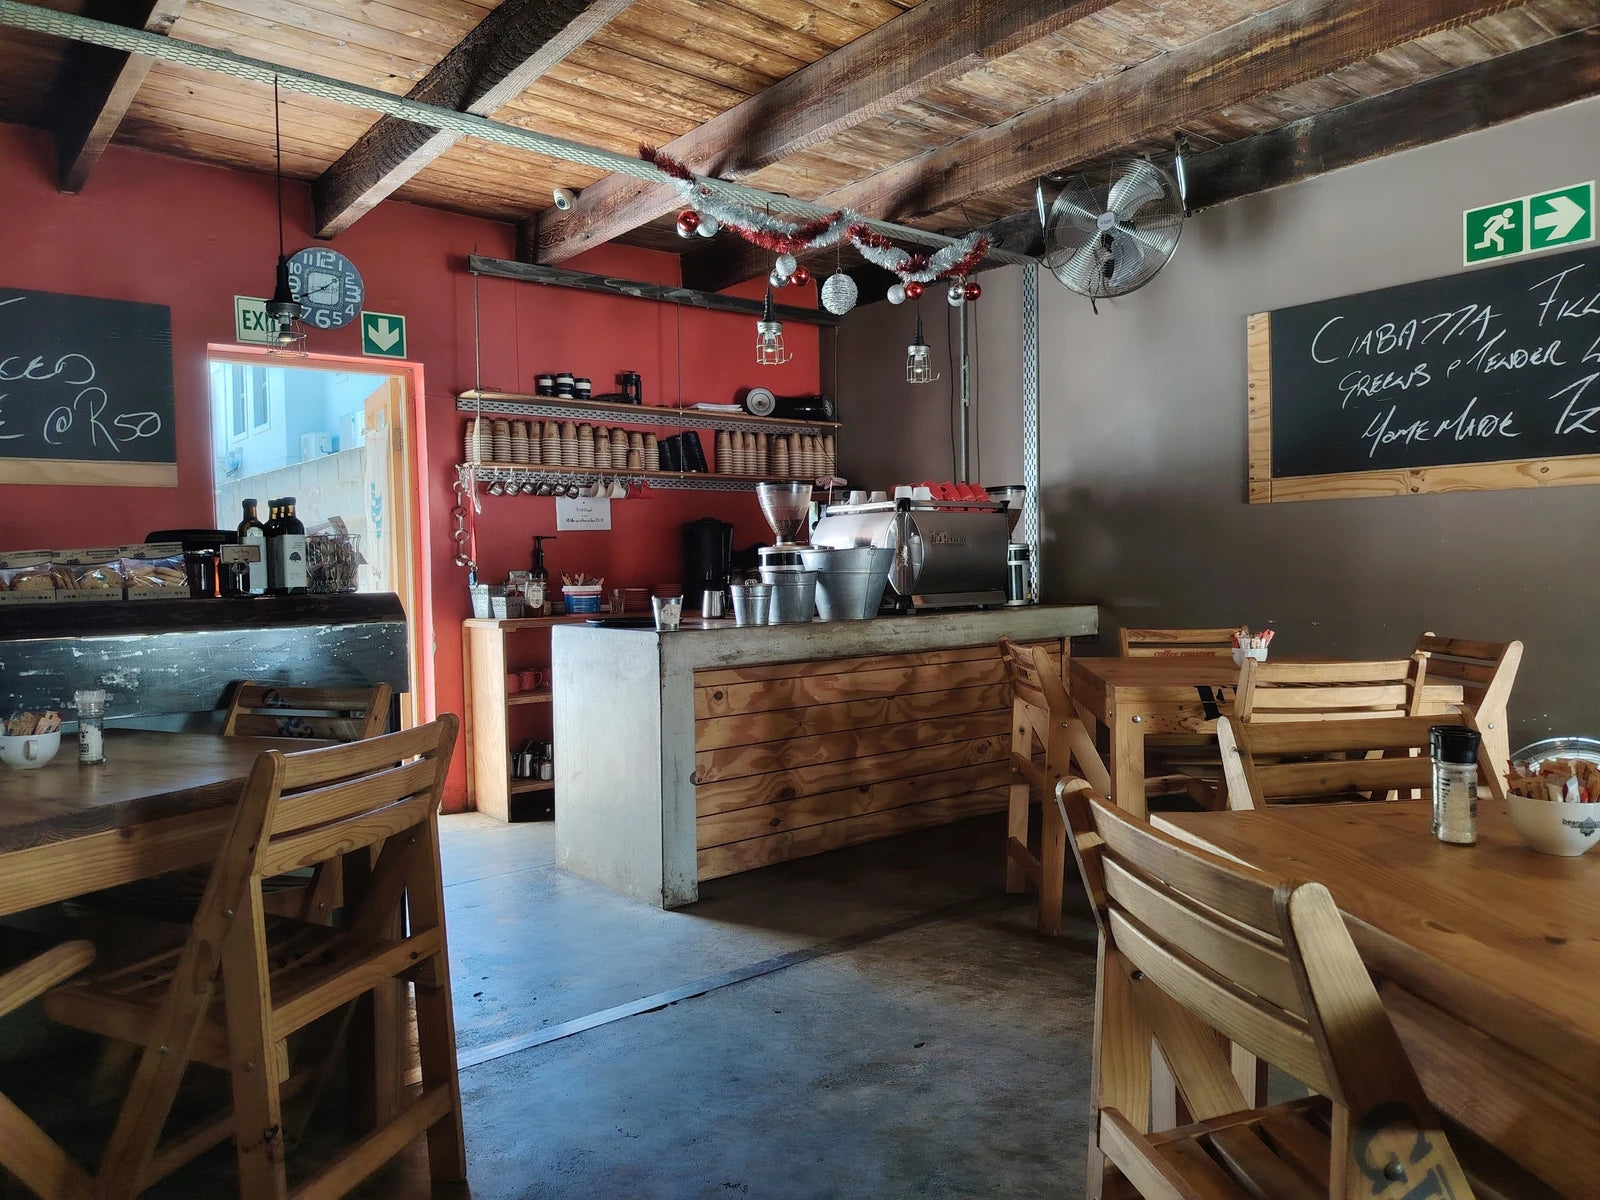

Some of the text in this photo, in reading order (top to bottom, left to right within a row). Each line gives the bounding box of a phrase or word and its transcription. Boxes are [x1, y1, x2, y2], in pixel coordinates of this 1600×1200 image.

[303, 253, 313, 265] 11
[317, 251, 336, 269] 12
[338, 260, 343, 271] 1
[289, 262, 302, 275] 10
[288, 275, 301, 293] 9
[345, 272, 355, 284] 2
[345, 285, 362, 303] 3
[302, 306, 313, 320] 7
[345, 304, 355, 317] 4
[315, 309, 331, 329] 6
[332, 311, 343, 325] 5
[1466, 328, 1568, 373] TENDER
